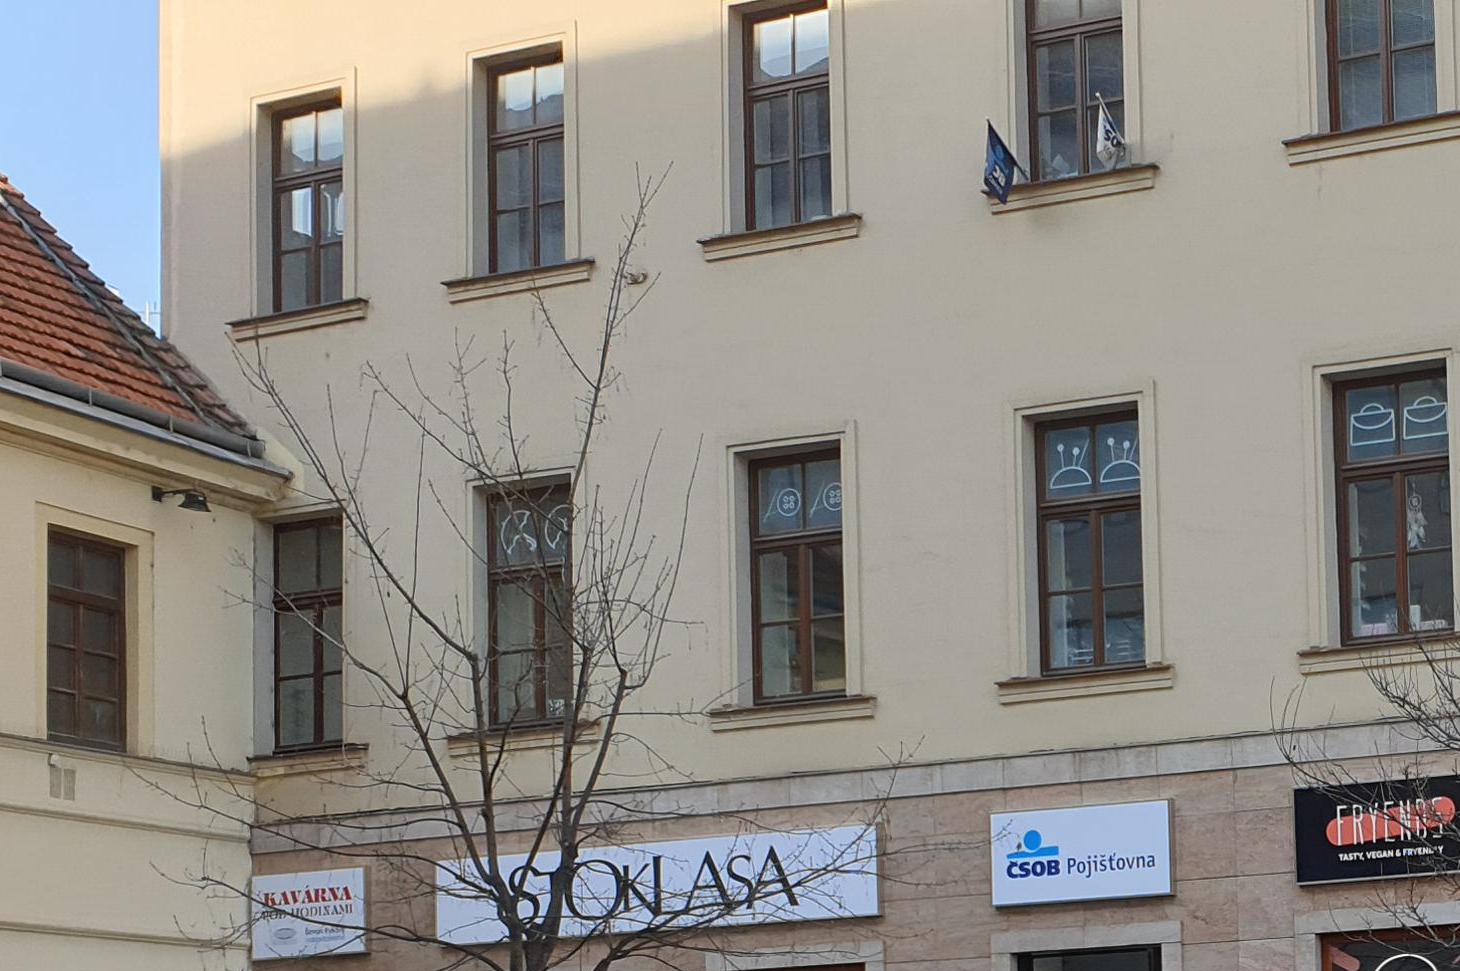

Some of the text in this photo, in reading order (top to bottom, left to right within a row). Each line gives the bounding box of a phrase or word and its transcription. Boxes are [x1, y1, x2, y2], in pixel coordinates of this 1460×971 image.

[1006, 851, 1156, 879] ČSOB Pojišťovna
[1339, 852, 1365, 862] TASTY,
[1366, 850, 1394, 859] VEGAN
[1395, 849, 1402, 857] &
[263, 884, 353, 907] KAVÁRNA
[509, 845, 799, 925] SOKLASA
